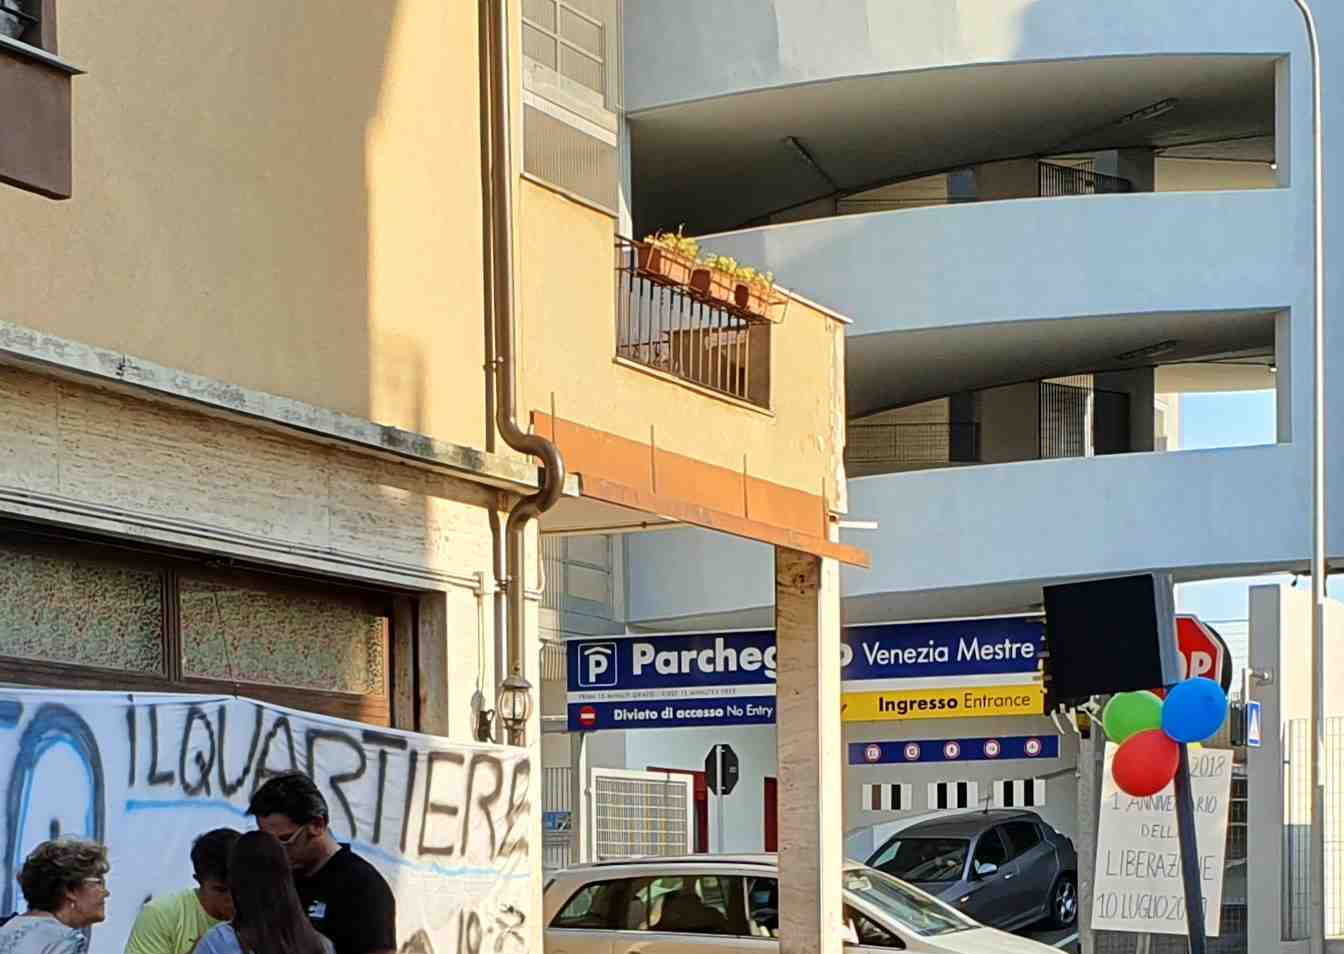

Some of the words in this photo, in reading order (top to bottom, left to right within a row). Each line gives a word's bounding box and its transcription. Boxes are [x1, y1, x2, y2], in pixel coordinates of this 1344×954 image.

[862, 640, 949, 665] Venezia
[957, 637, 1034, 662] Mestre
[614, 708, 658, 721] Divieto
[661, 706, 674, 719] di
[676, 707, 724, 719] accesso
[726, 705, 743, 717] No
[746, 703, 774, 717] Entry
[878, 697, 959, 715] Ingresso
[964, 692, 1031, 709] Entrance
[1140, 824, 1178, 839] DELL
[1106, 850, 1215, 881] LIBERAZIE
